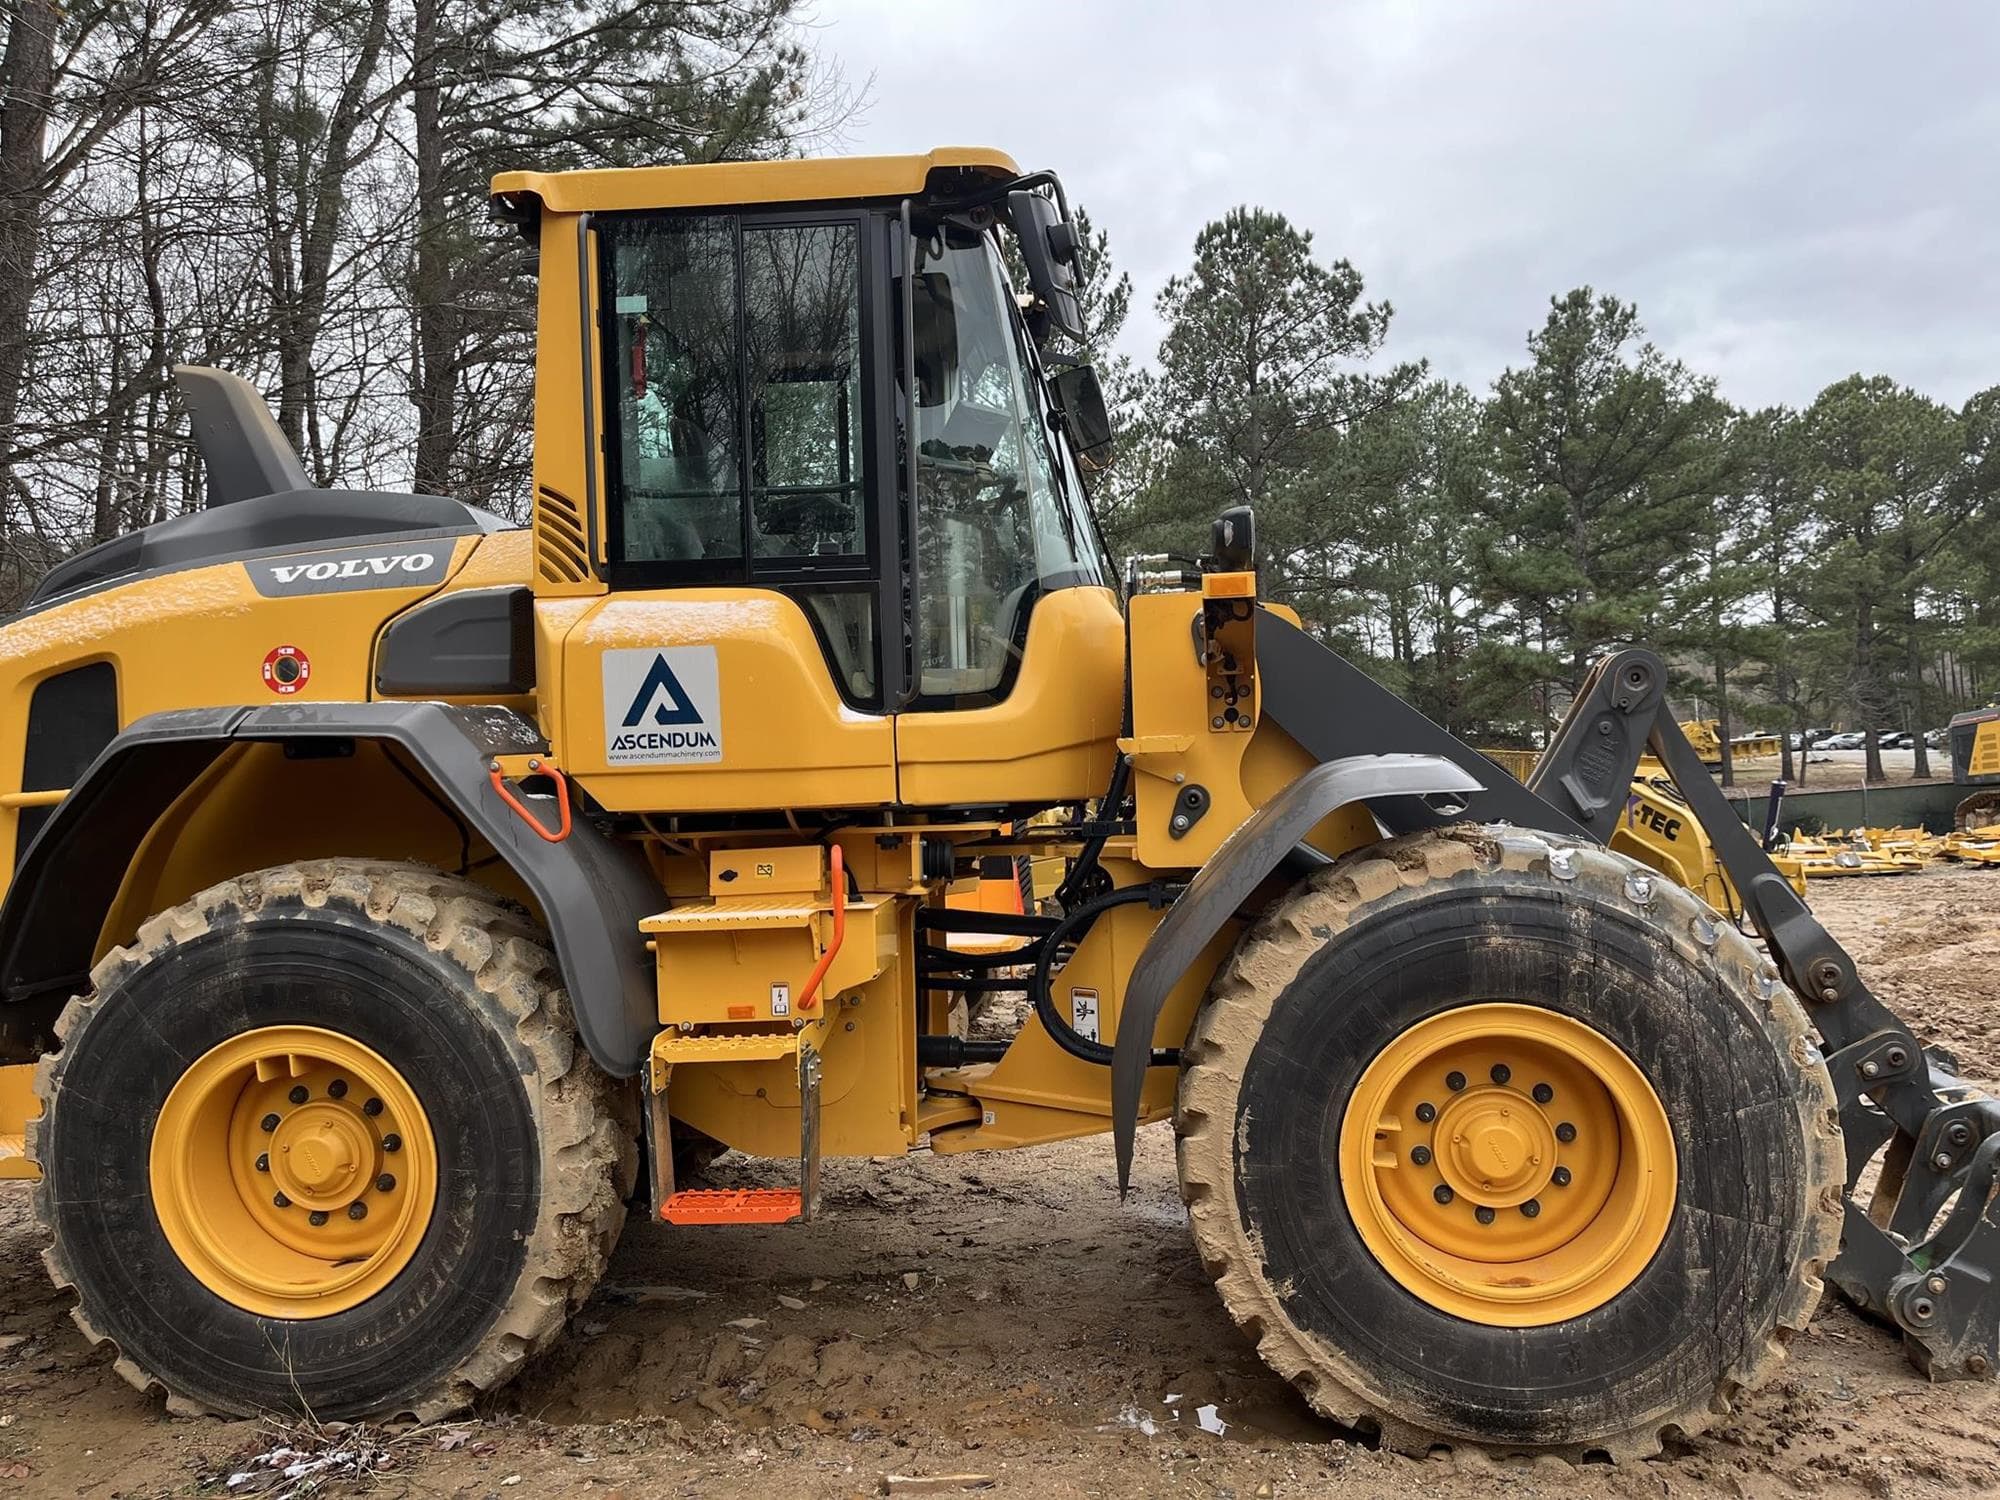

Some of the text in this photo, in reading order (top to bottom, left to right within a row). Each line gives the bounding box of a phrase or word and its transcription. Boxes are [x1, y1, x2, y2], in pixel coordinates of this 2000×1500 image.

[270, 553, 434, 584] VOLVO
[611, 731, 717, 751] ASCENDUM
[608, 750, 721, 761] www.ascendummachinery.com
